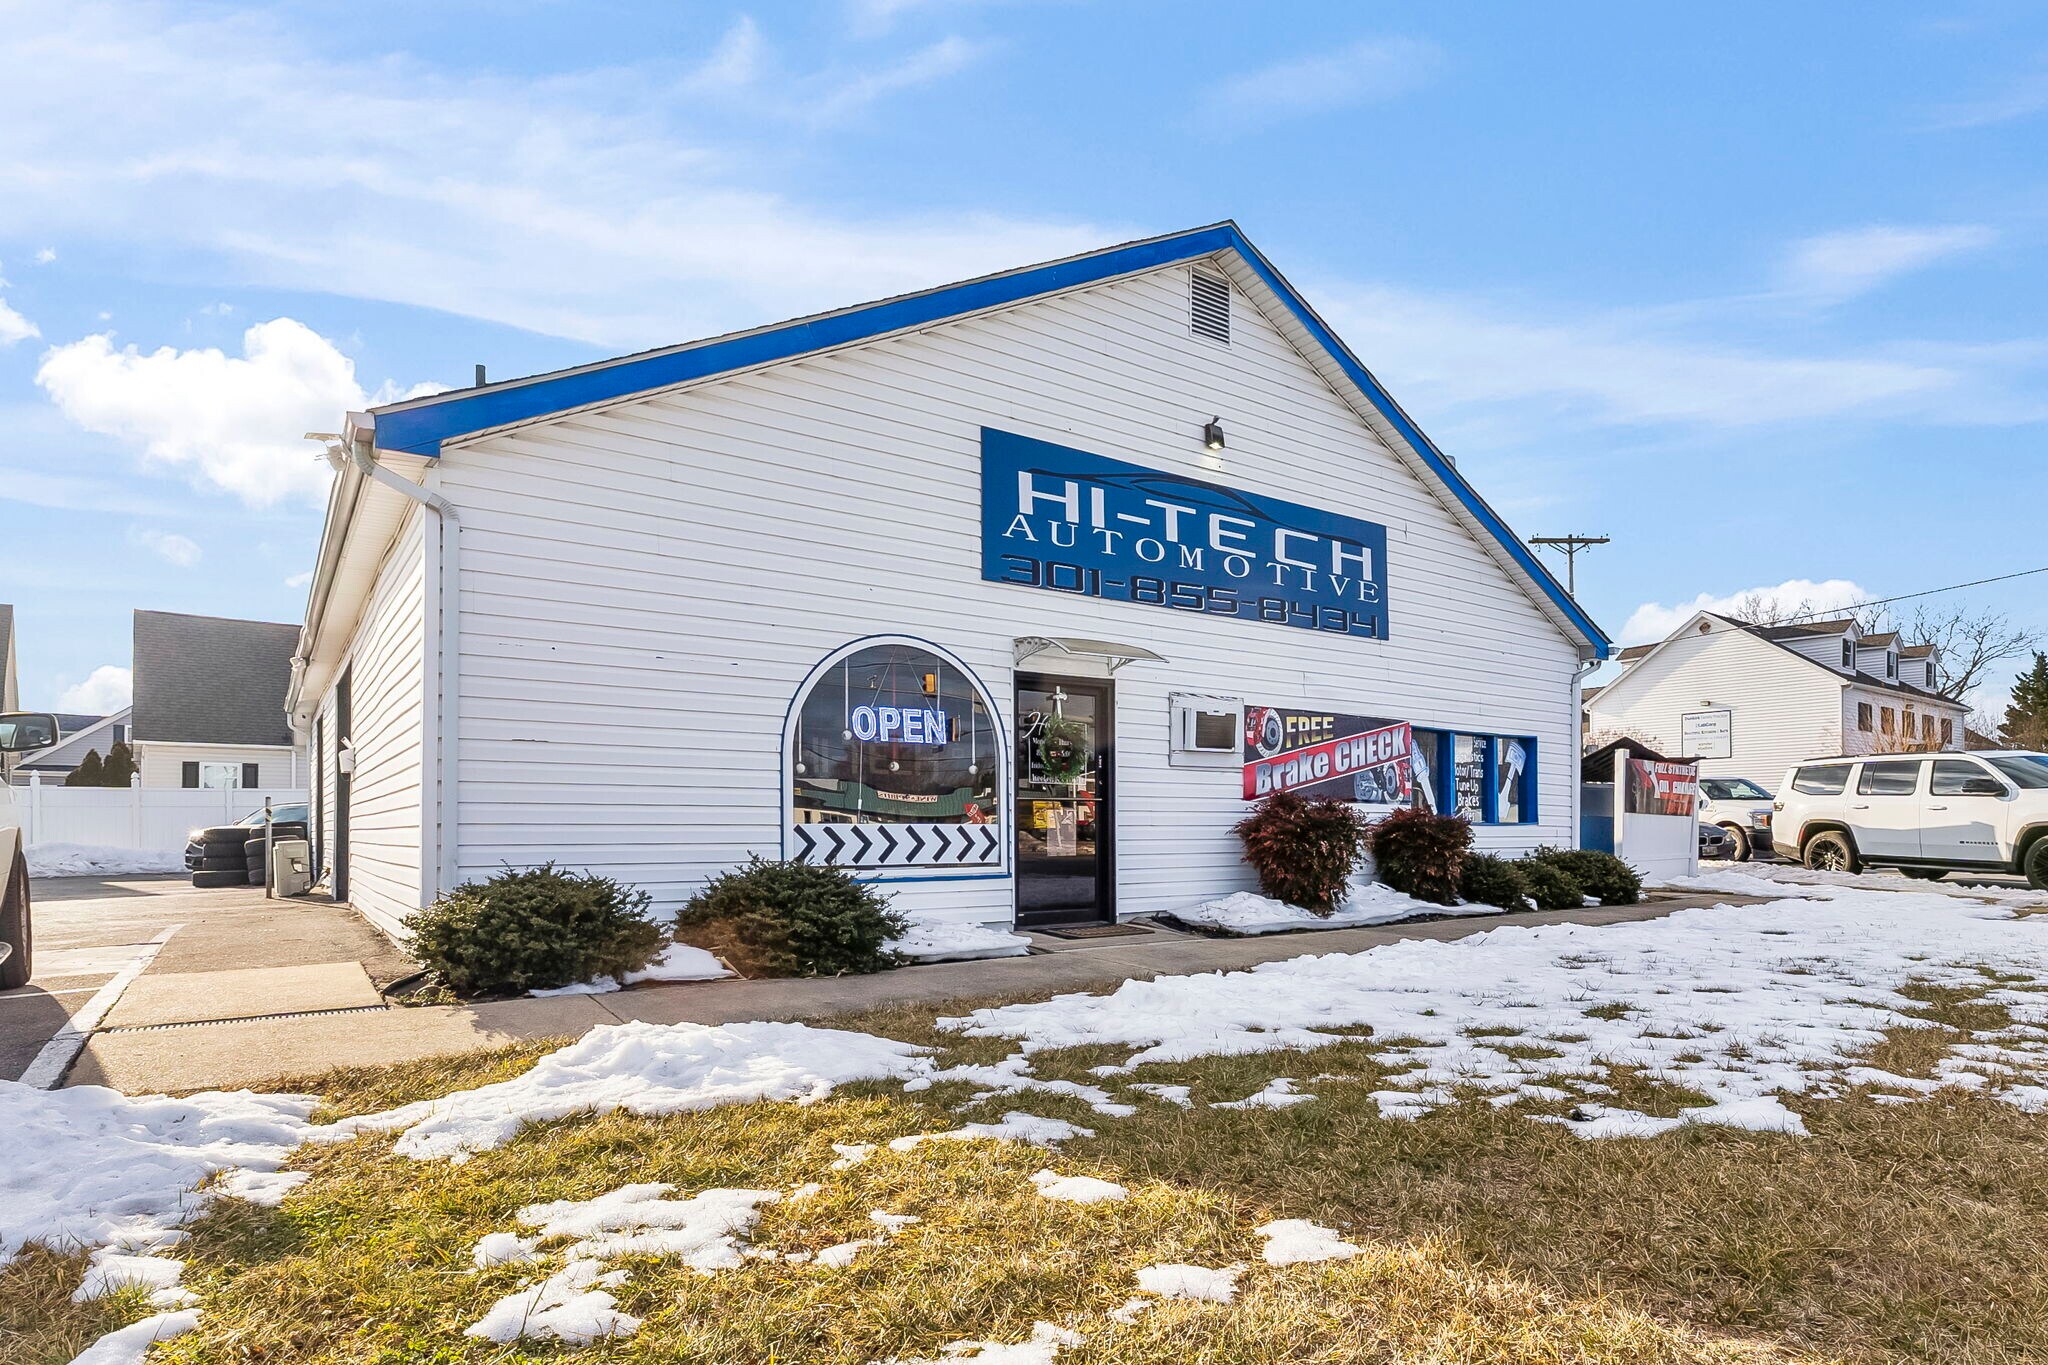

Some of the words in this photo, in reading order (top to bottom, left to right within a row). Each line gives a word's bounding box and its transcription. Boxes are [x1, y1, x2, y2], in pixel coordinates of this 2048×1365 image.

[1002, 514, 1381, 604] AUTOMOTIVE
[1018, 470, 1373, 581] HI-TECH
[1001, 553, 1379, 639] 301-855-8434
[852, 705, 947, 745] OPEN
[1285, 716, 1335, 749] FREE
[1255, 750, 1330, 797] Brake
[1334, 727, 1407, 773] CHECK
[1457, 792, 1480, 807] Brakes
